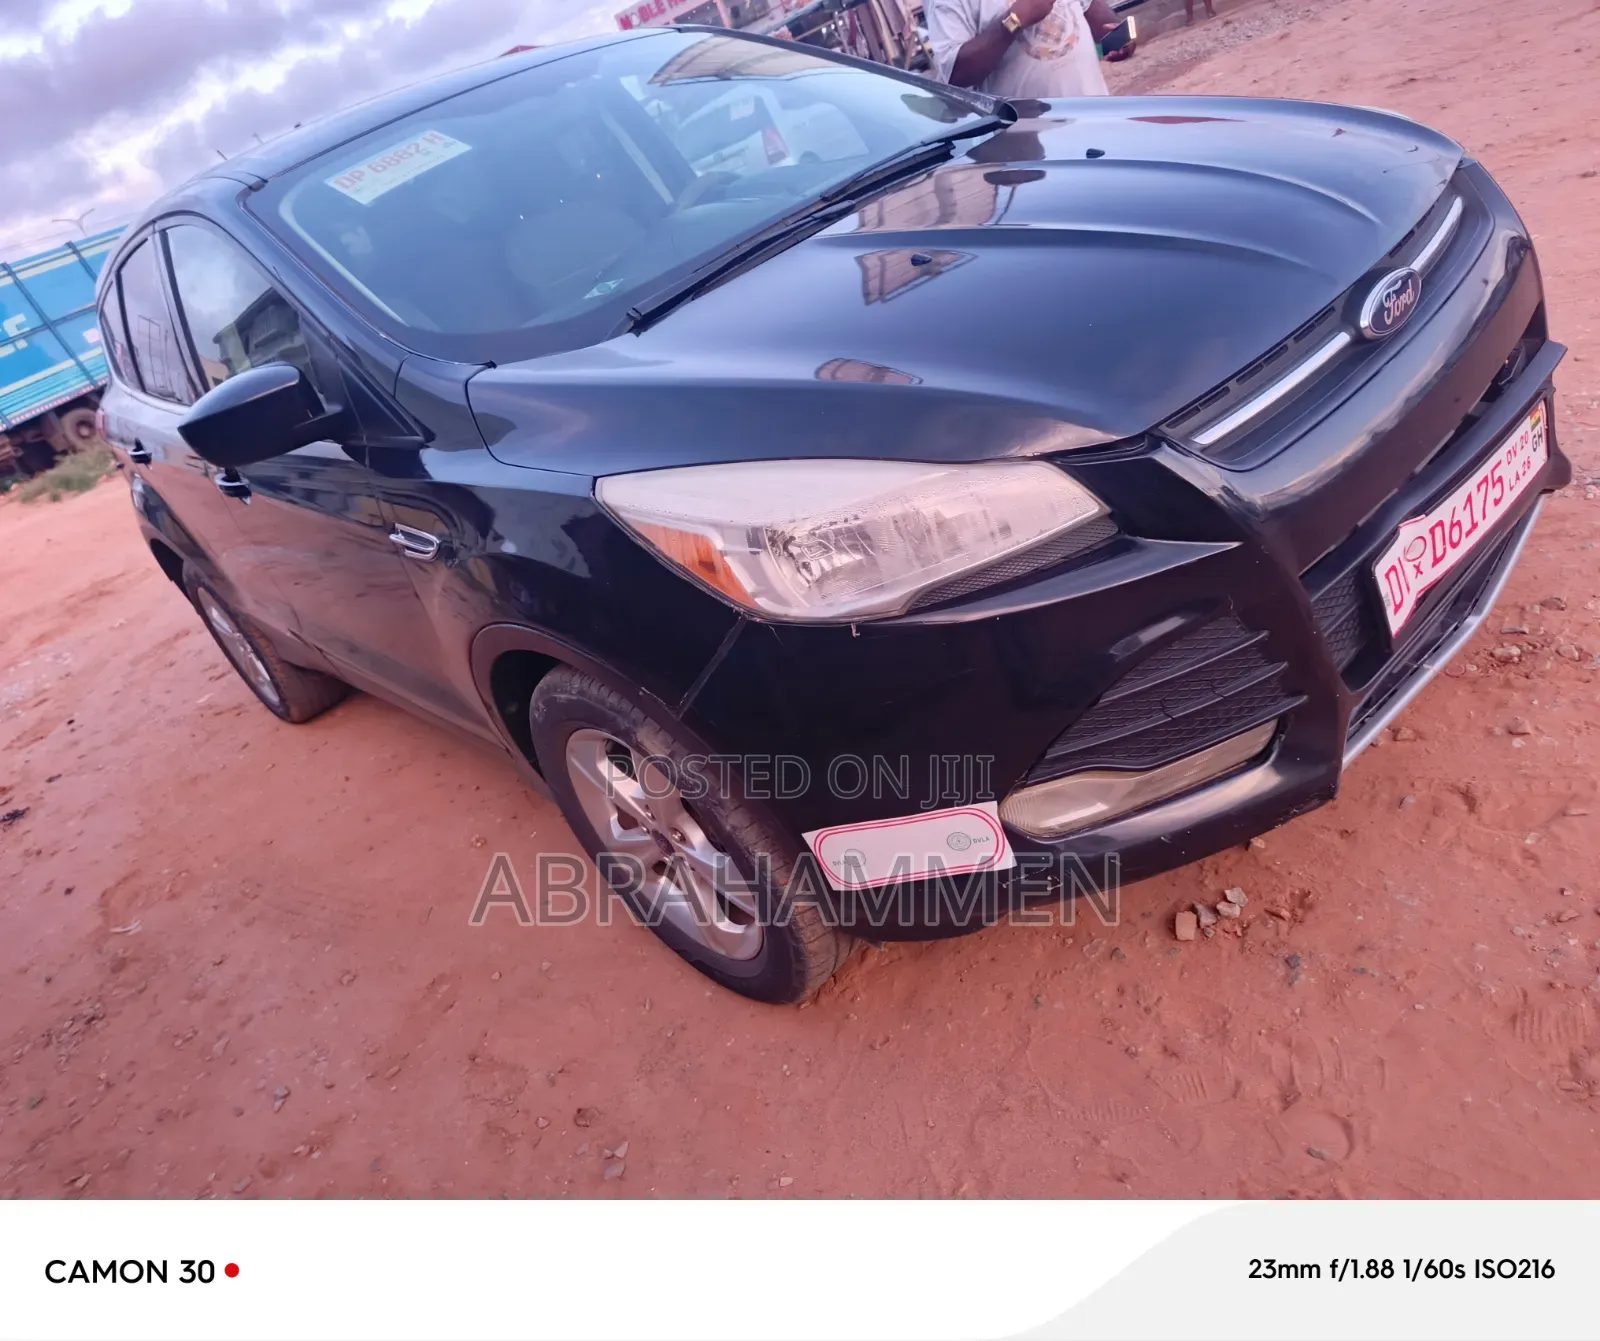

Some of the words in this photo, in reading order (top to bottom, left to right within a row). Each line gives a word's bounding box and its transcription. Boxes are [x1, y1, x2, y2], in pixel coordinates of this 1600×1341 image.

[620, 0, 667, 30] NOBLE
[333, 169, 365, 189] DP
[1382, 278, 1415, 325] Ford
[1506, 442, 1518, 466] DV
[1520, 430, 1529, 451] 20
[1532, 426, 1543, 453] GH
[972, 836, 990, 844] DVLA
